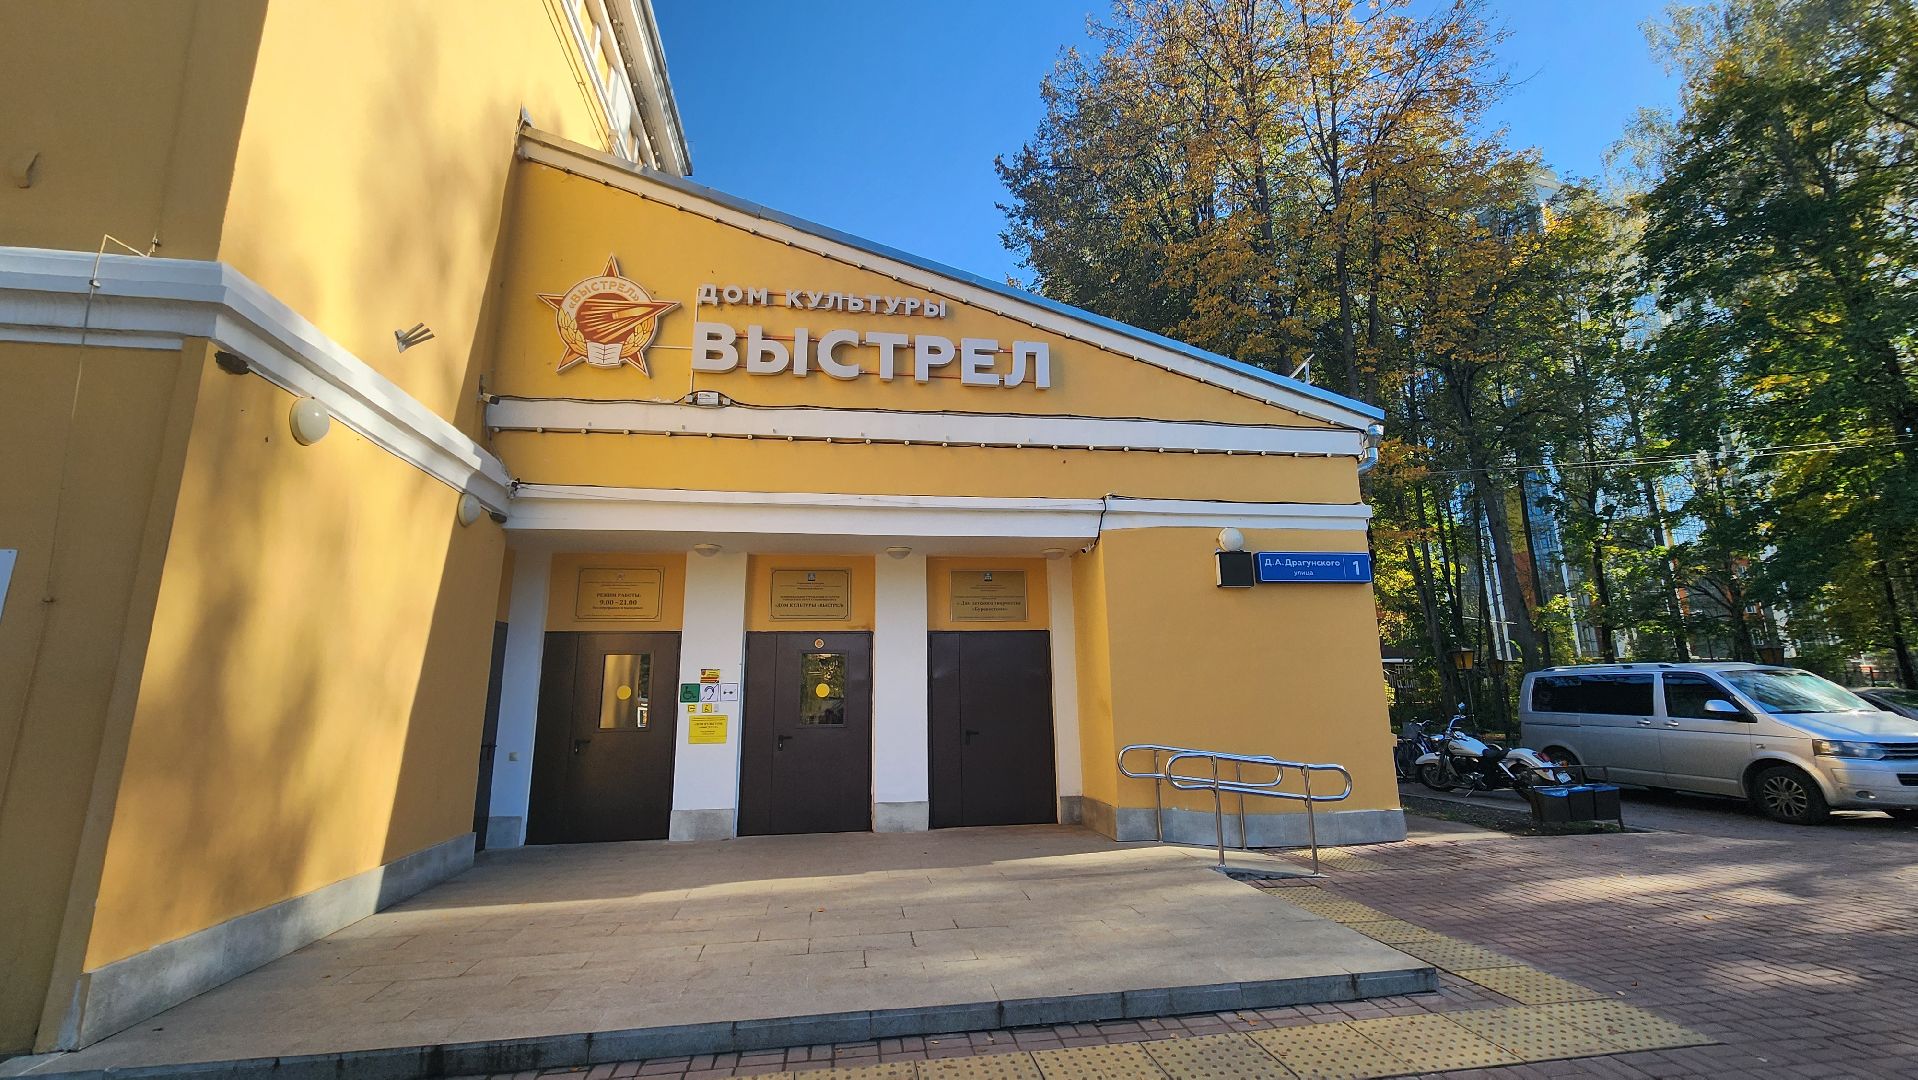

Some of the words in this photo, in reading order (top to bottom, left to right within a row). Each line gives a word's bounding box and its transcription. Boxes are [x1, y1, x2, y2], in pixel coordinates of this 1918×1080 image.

[568, 280, 640, 309] «ВЫСТРЕЛ»
[697, 283, 769, 306] ДОМ
[785, 288, 947, 319] КУЛЬТУРЫ
[691, 321, 1050, 390] ВЫСТРЕЛ
[1352, 560, 1361, 576] 1
